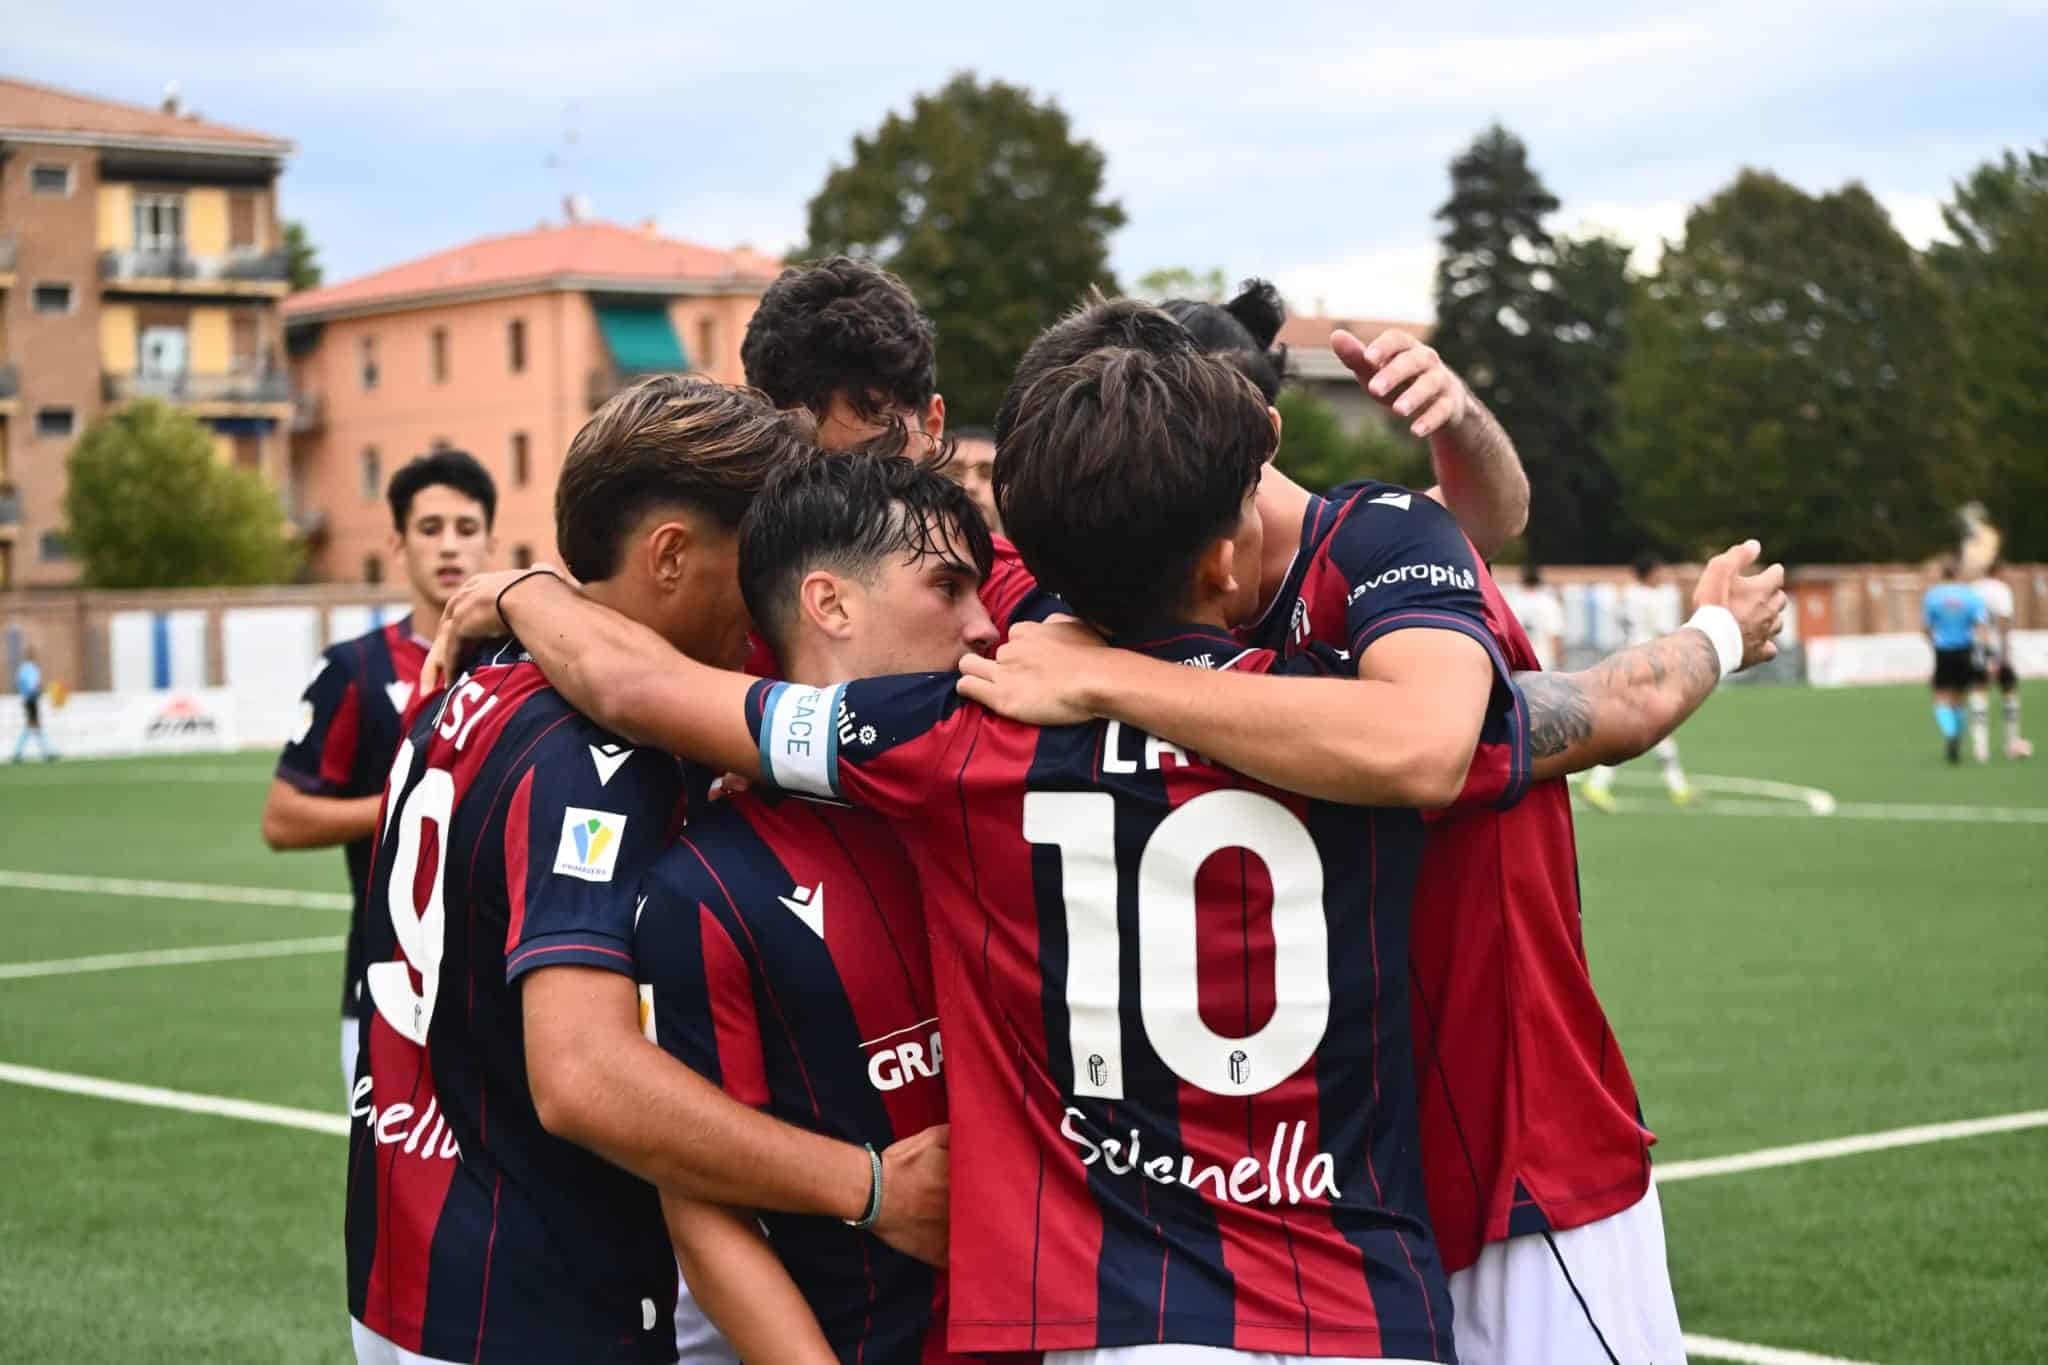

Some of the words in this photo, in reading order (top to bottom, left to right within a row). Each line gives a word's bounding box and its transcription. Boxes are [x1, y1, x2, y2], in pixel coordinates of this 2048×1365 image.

[1177, 653, 1215, 671] ONE
[432, 672, 498, 751] SI
[787, 689, 820, 757] EACE
[1023, 789, 1331, 1100] 10
